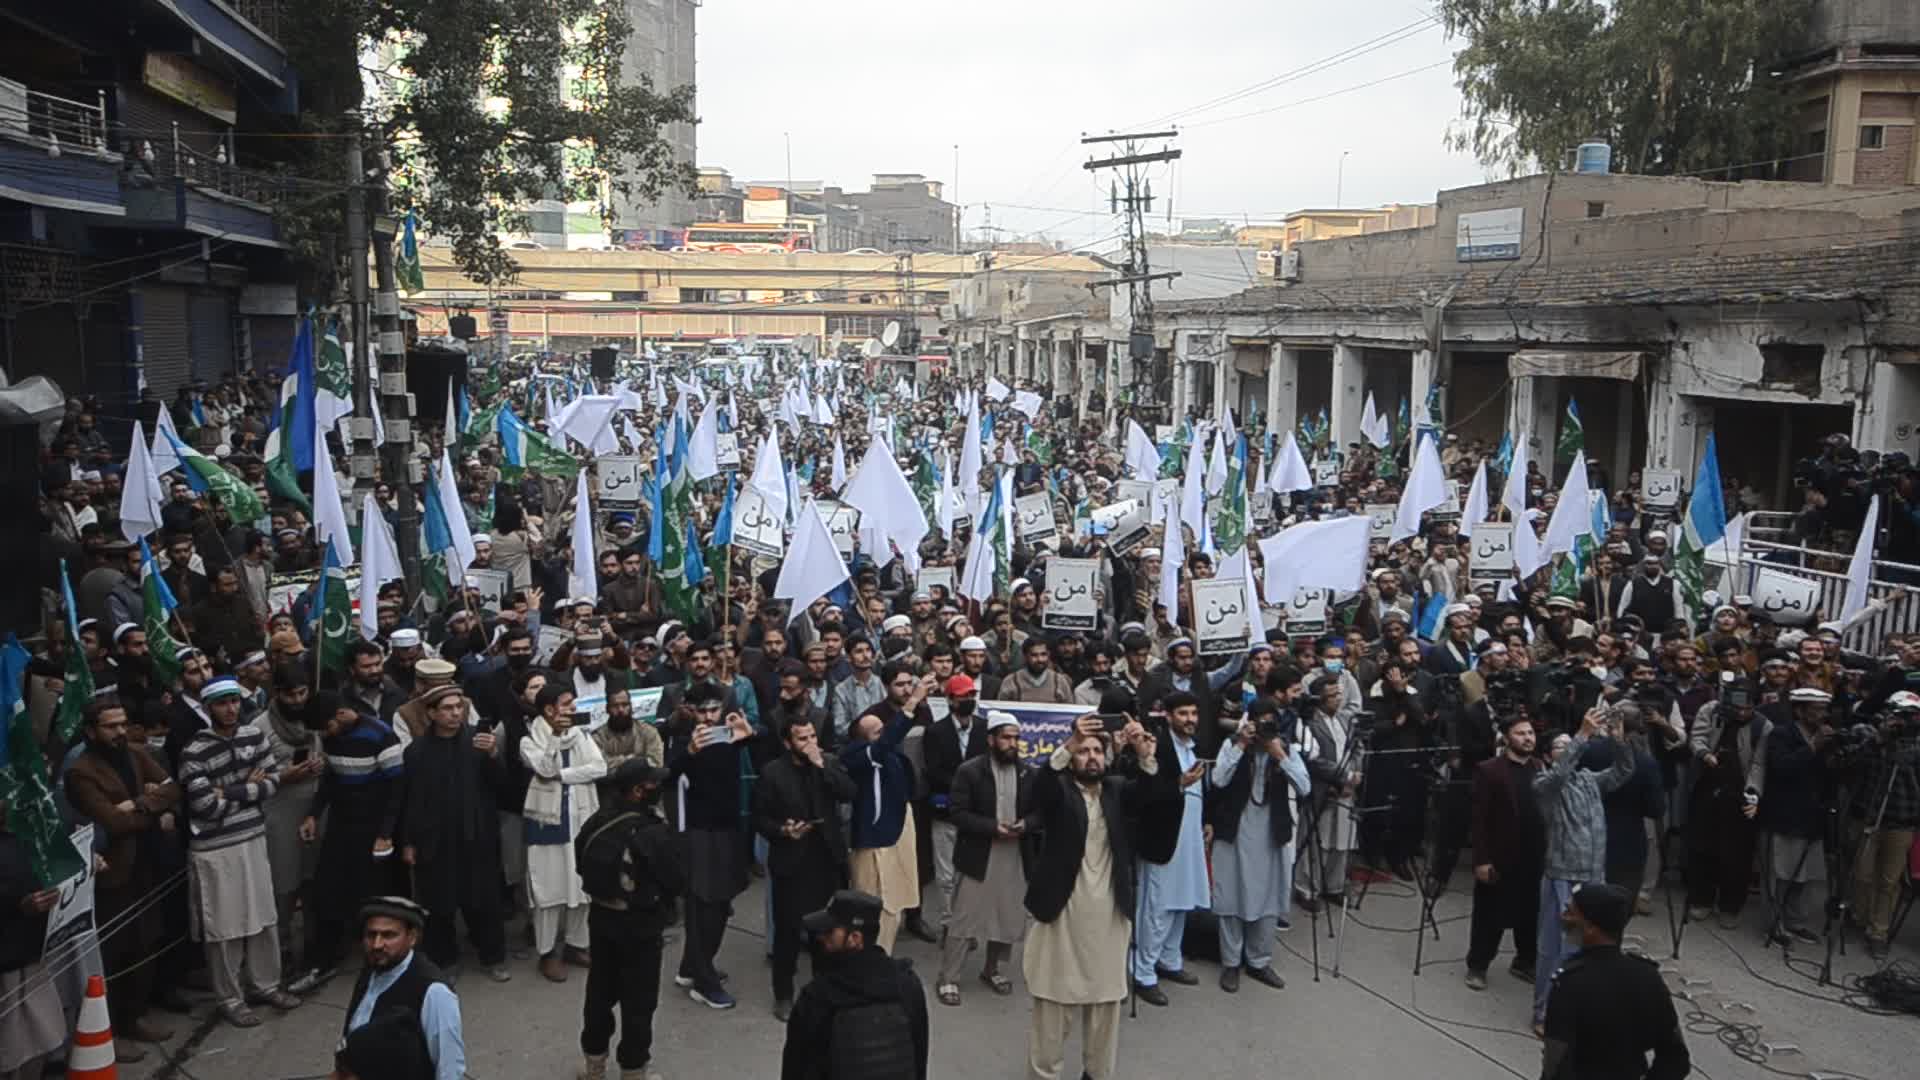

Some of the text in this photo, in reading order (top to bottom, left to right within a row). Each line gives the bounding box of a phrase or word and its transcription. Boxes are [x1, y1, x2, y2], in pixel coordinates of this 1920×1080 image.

[605, 464, 637, 489] امن
[1648, 476, 1678, 497] امن
[1024, 499, 1050, 525] امن
[1372, 511, 1397, 530] امن
[1478, 532, 1512, 558] امن
[1055, 570, 1096, 602] امن
[1294, 586, 1327, 609] امن
[1206, 588, 1246, 625] امن
[1764, 589, 1814, 612] امن
